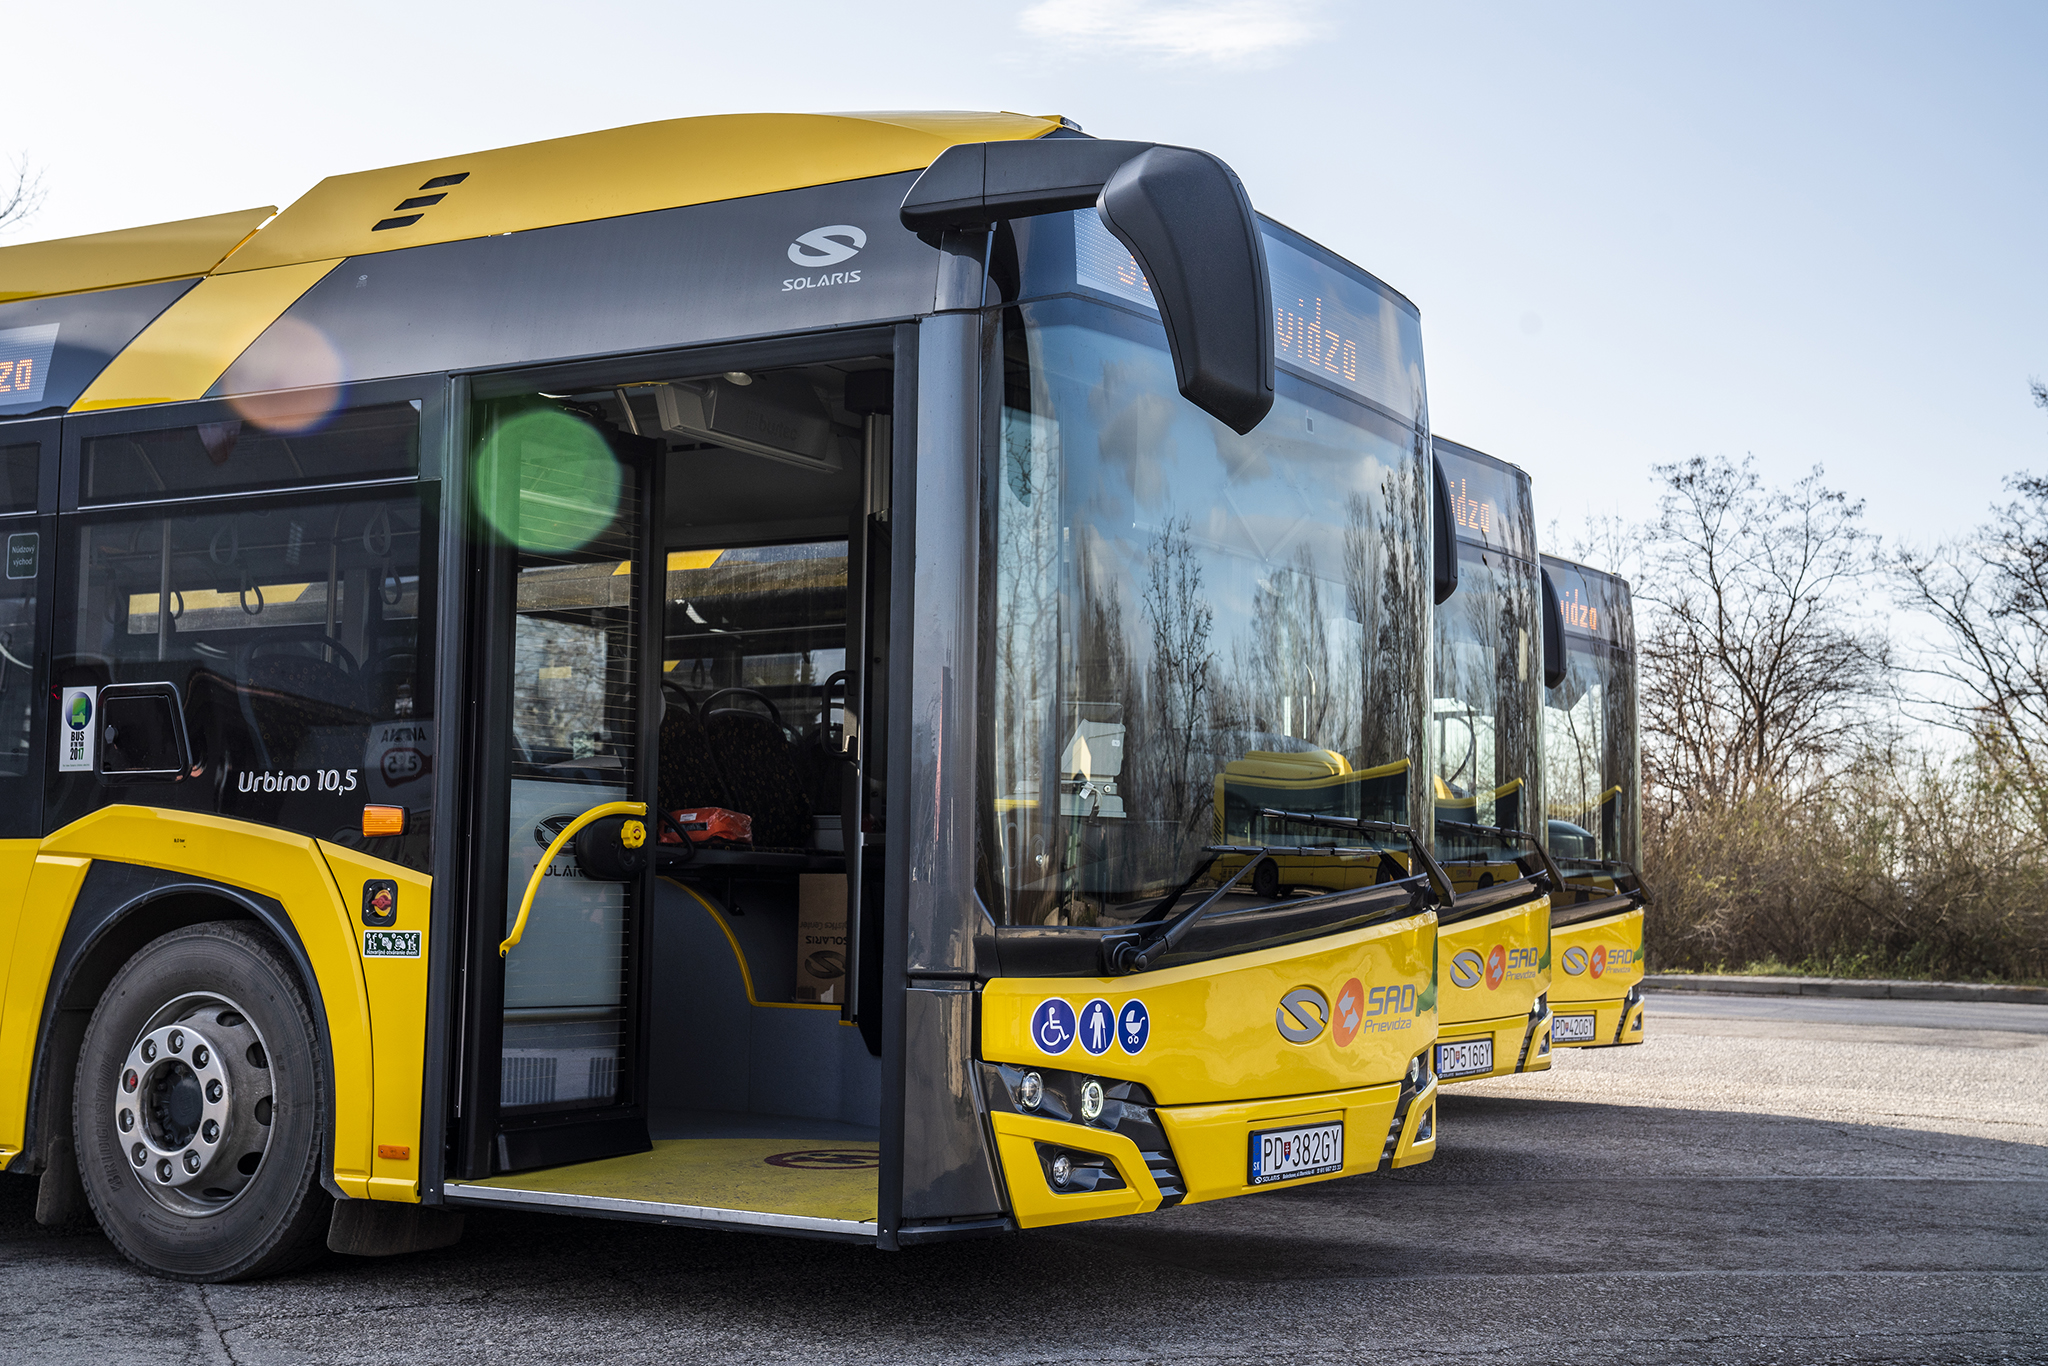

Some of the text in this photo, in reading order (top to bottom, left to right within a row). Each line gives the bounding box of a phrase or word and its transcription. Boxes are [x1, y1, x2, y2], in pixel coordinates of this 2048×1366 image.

[781, 270, 862, 292] SOLARIS
[11, 544, 35, 555] Núdzový
[12, 557, 33, 568] východ
[71, 731, 84, 741] BUS
[70, 747, 84, 760] 2017
[238, 769, 358, 796] Urbino 10,5
[1507, 946, 1538, 969] SAD
[1607, 948, 1633, 966] SAD
[1505, 969, 1536, 981] Prievidza
[1366, 983, 1416, 1017] SAD
[1363, 1016, 1413, 1035] Prievidza
[1253, 1161, 1261, 1171] SK
